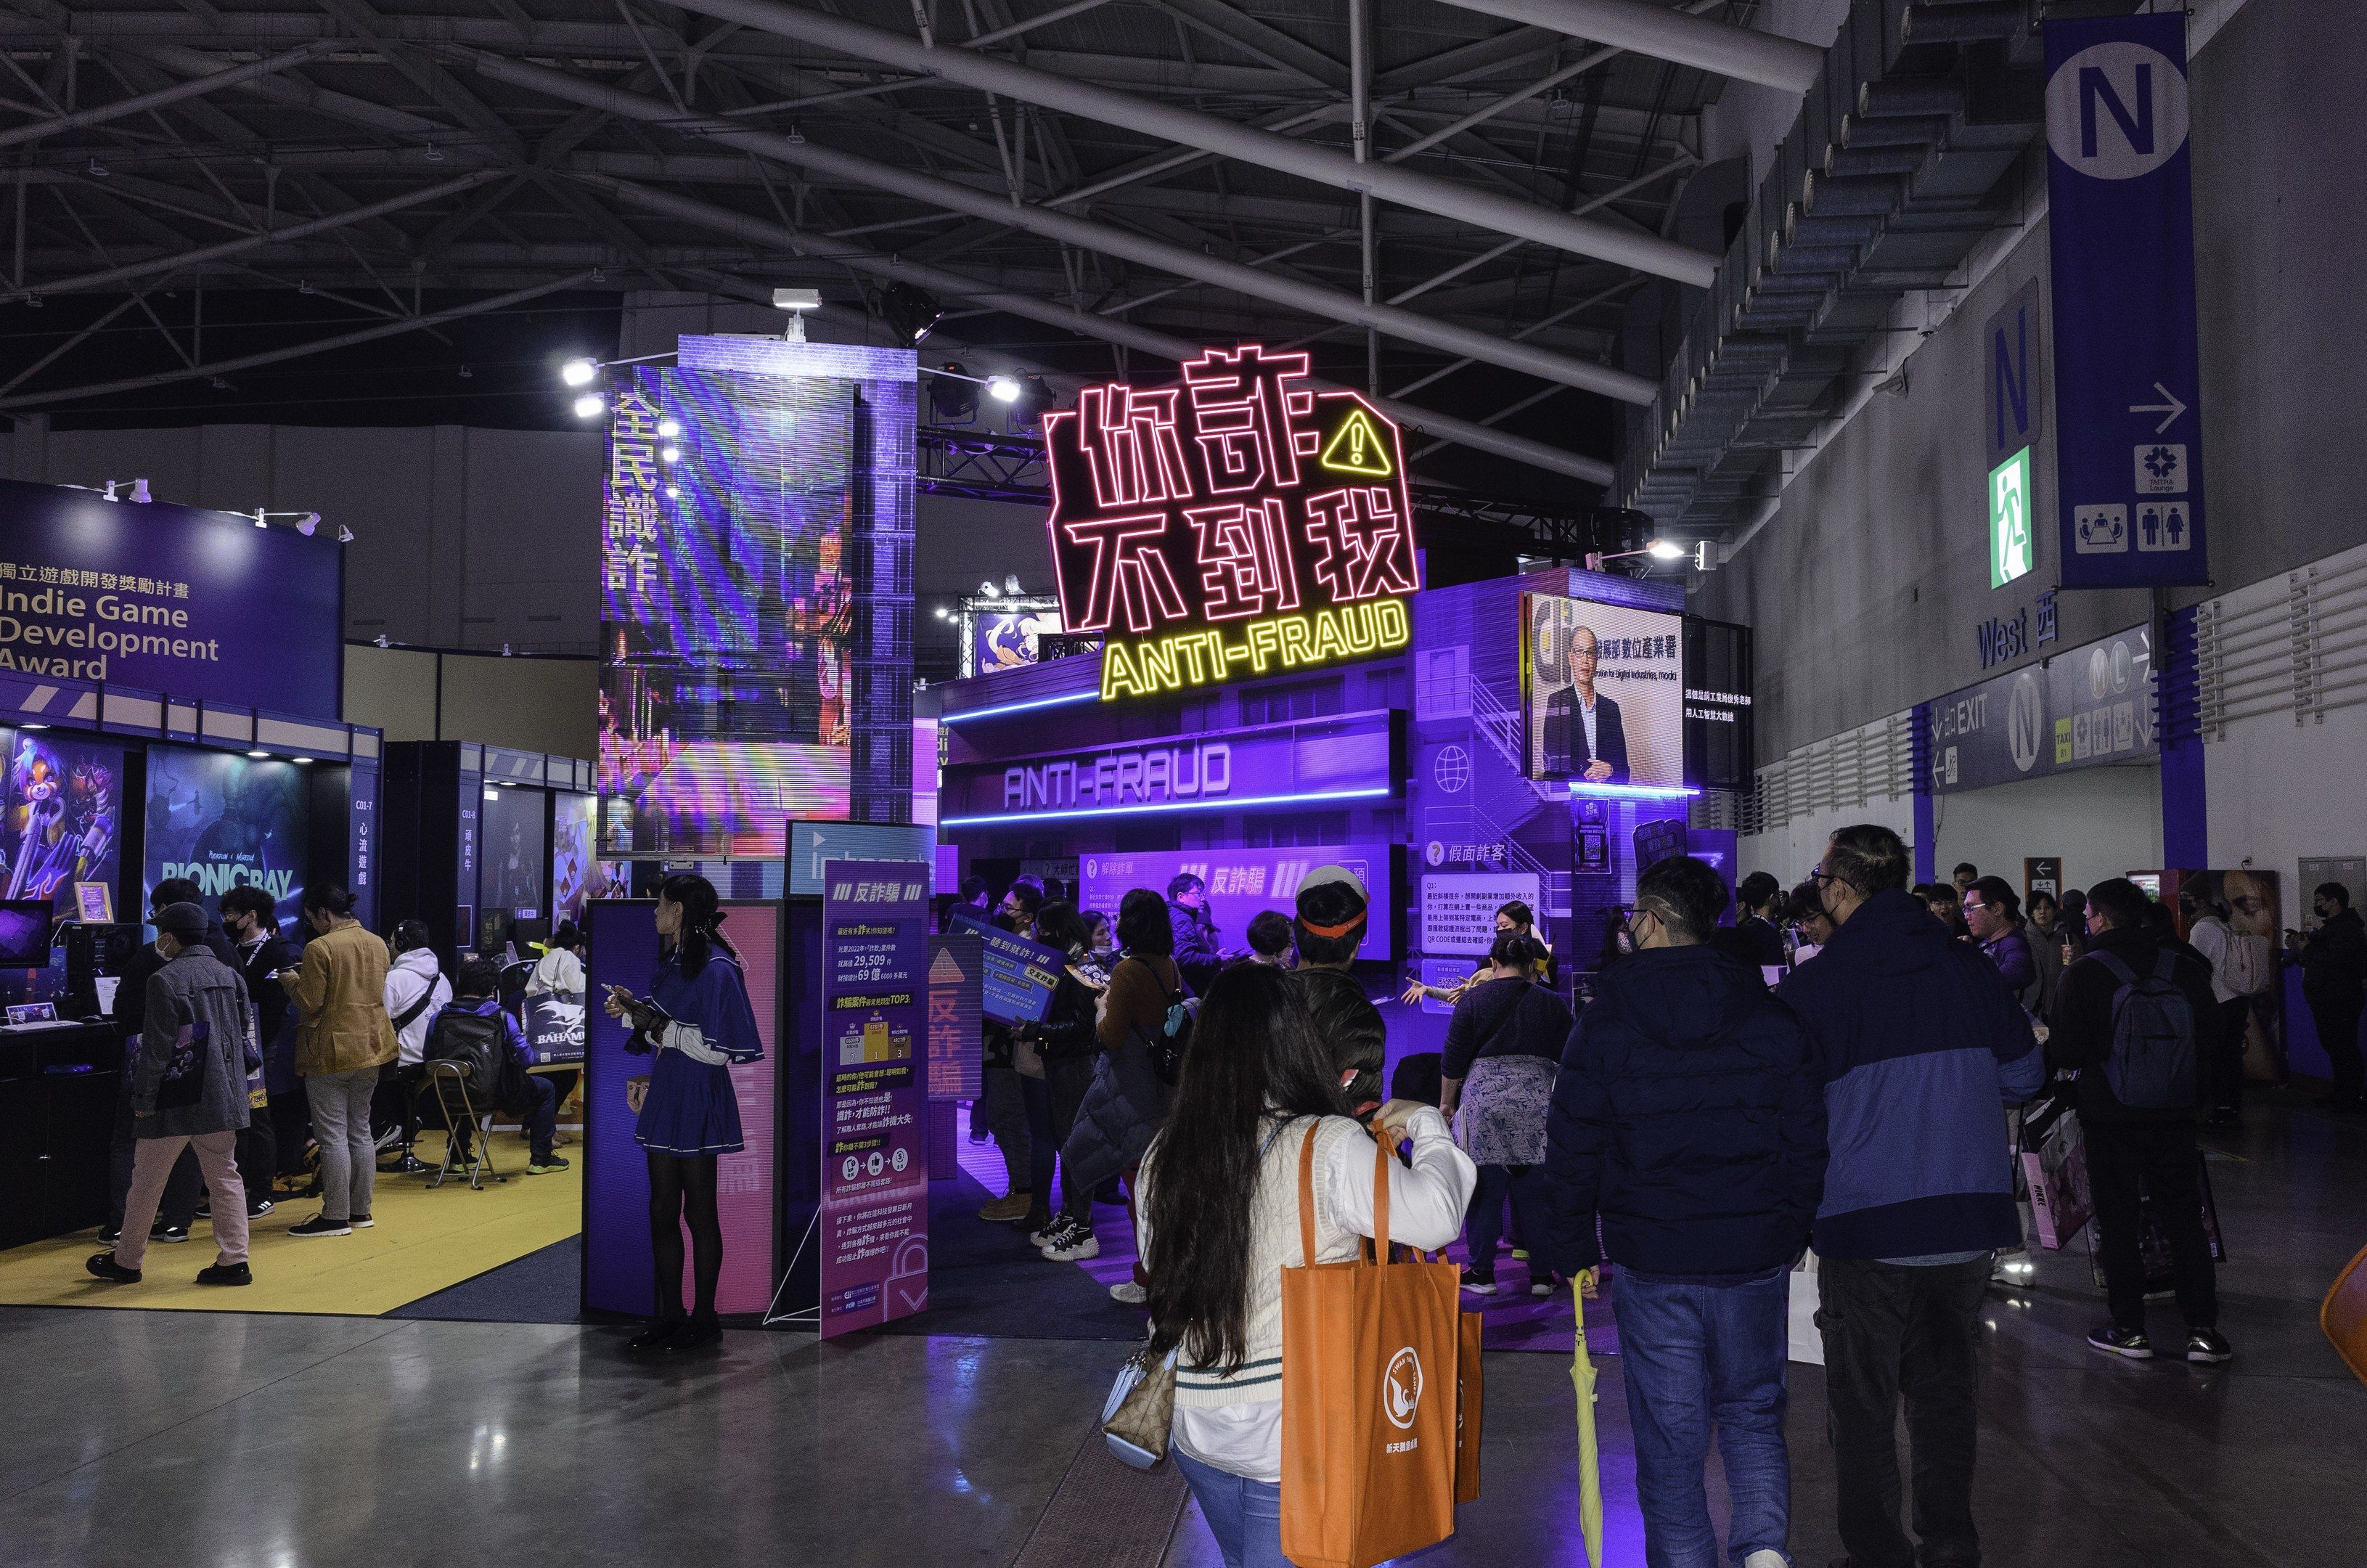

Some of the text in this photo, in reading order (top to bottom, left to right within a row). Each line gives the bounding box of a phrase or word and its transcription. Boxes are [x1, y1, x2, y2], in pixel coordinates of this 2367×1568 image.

[2079, 63, 2154, 158] N
[1995, 306, 2028, 450] N
[608, 393, 661, 592] 全民識詐
[1064, 487, 1420, 633] 不到我
[0, 562, 189, 599] 獨立遊戲開發獎勵計畫
[0, 584, 189, 628] Indie Game
[0, 617, 219, 661] Development
[1976, 591, 2059, 669] West 西
[0, 648, 107, 680] Award
[1100, 597, 1410, 702] ANTI-FRAUD
[1958, 692, 1988, 735] EXIT
[2016, 688, 2035, 759] N
[2056, 732, 2071, 745] TAXI
[1004, 744, 1230, 811] ANTI-FRAUD
[356, 800, 372, 810] C01-7
[462, 809, 476, 819] C01-8
[358, 822, 368, 886] 心流遊戲
[1449, 844, 1505, 862] 假面詐客
[854, 882, 901, 902] 反詐騙
[1211, 867, 1265, 894] 反詐騙
[854, 955, 886, 968] 29,509
[981, 936, 1036, 960] 一聽到就詐!
[871, 968, 880, 981] 億
[1028, 968, 1056, 987] 交友詐騙
[928, 989, 962, 1095] 反詐騙
[2034, 1185, 2046, 1206] NIKKE
[1393, 1357, 1406, 1375] SWAN
